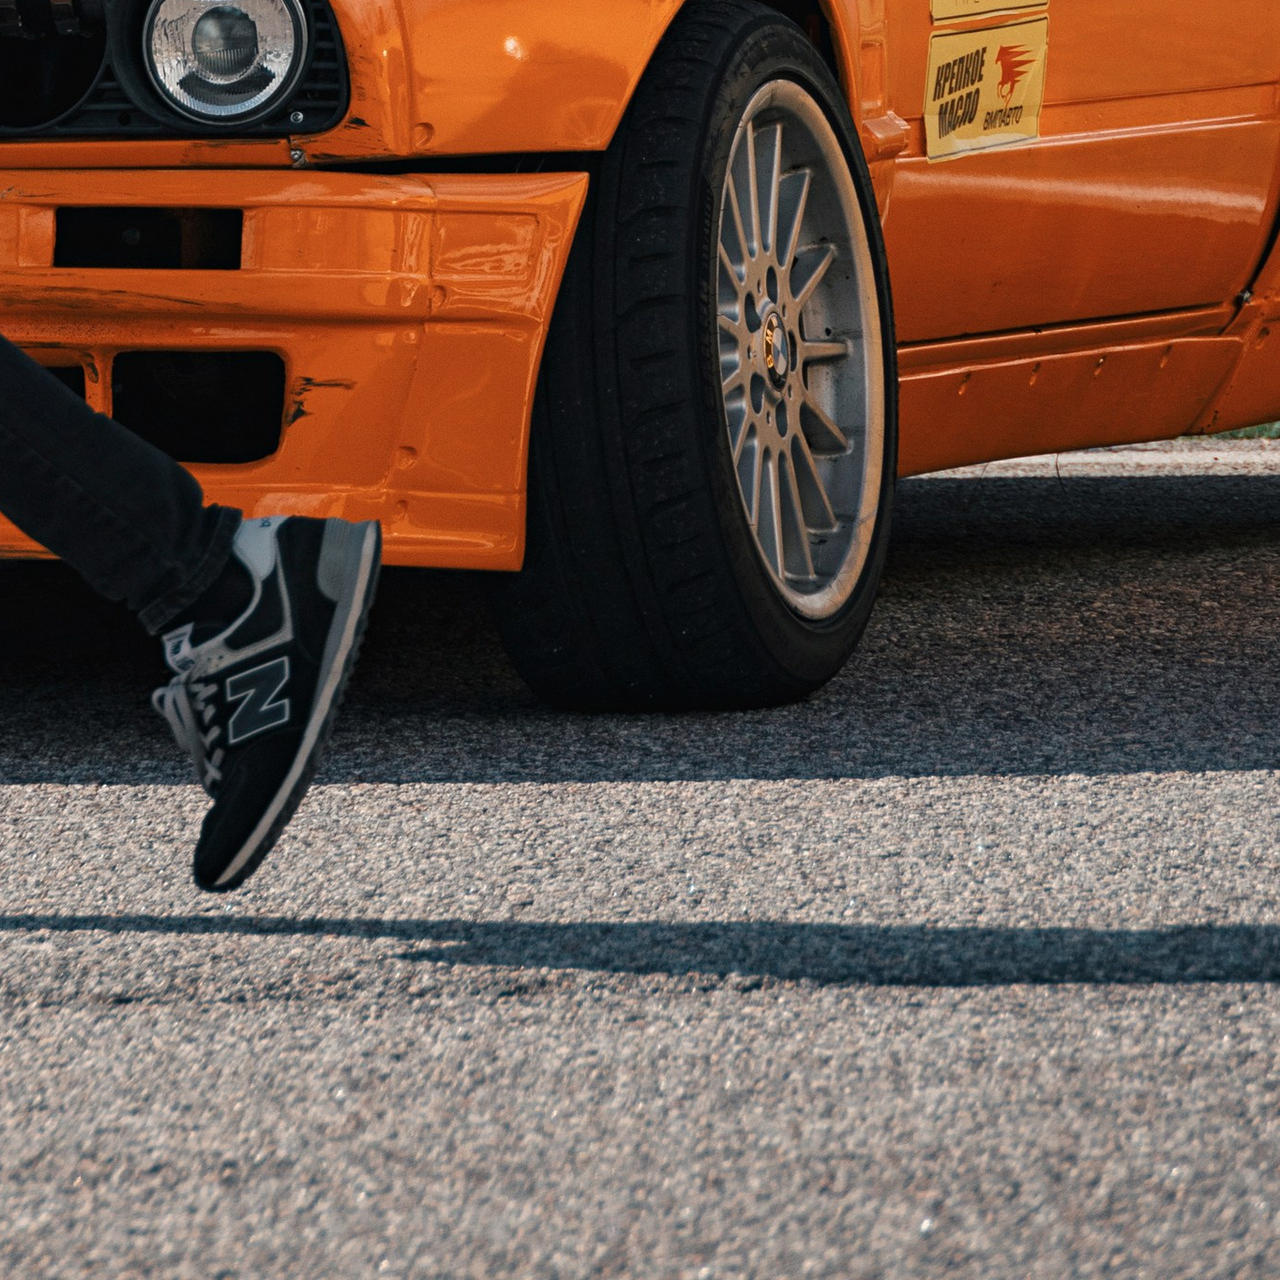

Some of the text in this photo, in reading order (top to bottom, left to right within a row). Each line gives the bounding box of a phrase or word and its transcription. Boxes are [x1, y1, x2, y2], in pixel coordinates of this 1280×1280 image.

[932, 46, 988, 102] КРЕПКОЕ
[937, 87, 981, 140] МАСЛО
[982, 104, 1024, 131] ВМПАВТО
